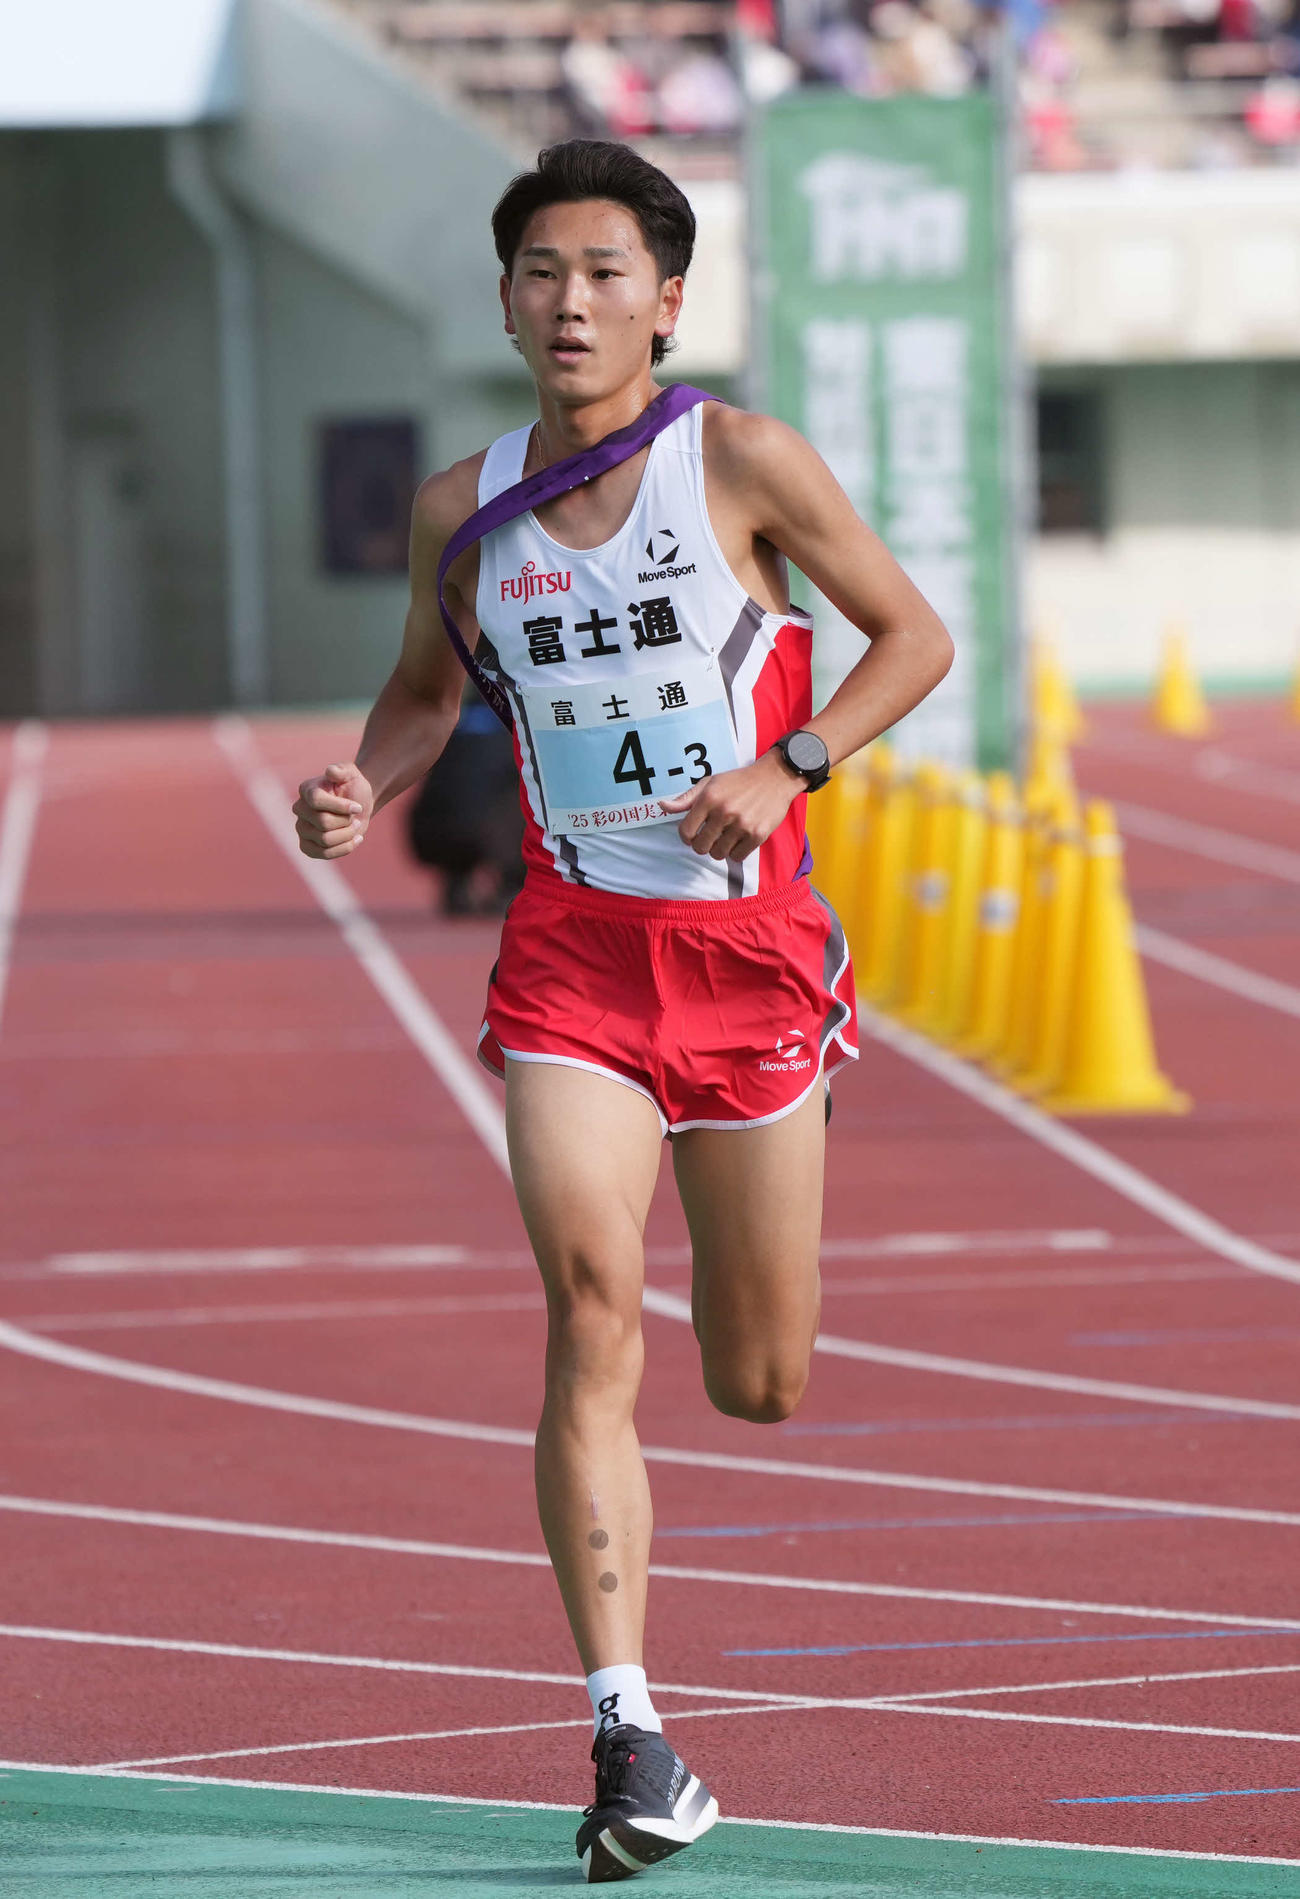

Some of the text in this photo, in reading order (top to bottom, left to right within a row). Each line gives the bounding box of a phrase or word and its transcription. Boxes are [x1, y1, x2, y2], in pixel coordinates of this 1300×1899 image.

[500, 561, 571, 605] FUJITSU
[523, 596, 682, 666] 富士通
[613, 730, 712, 796] 4-3
